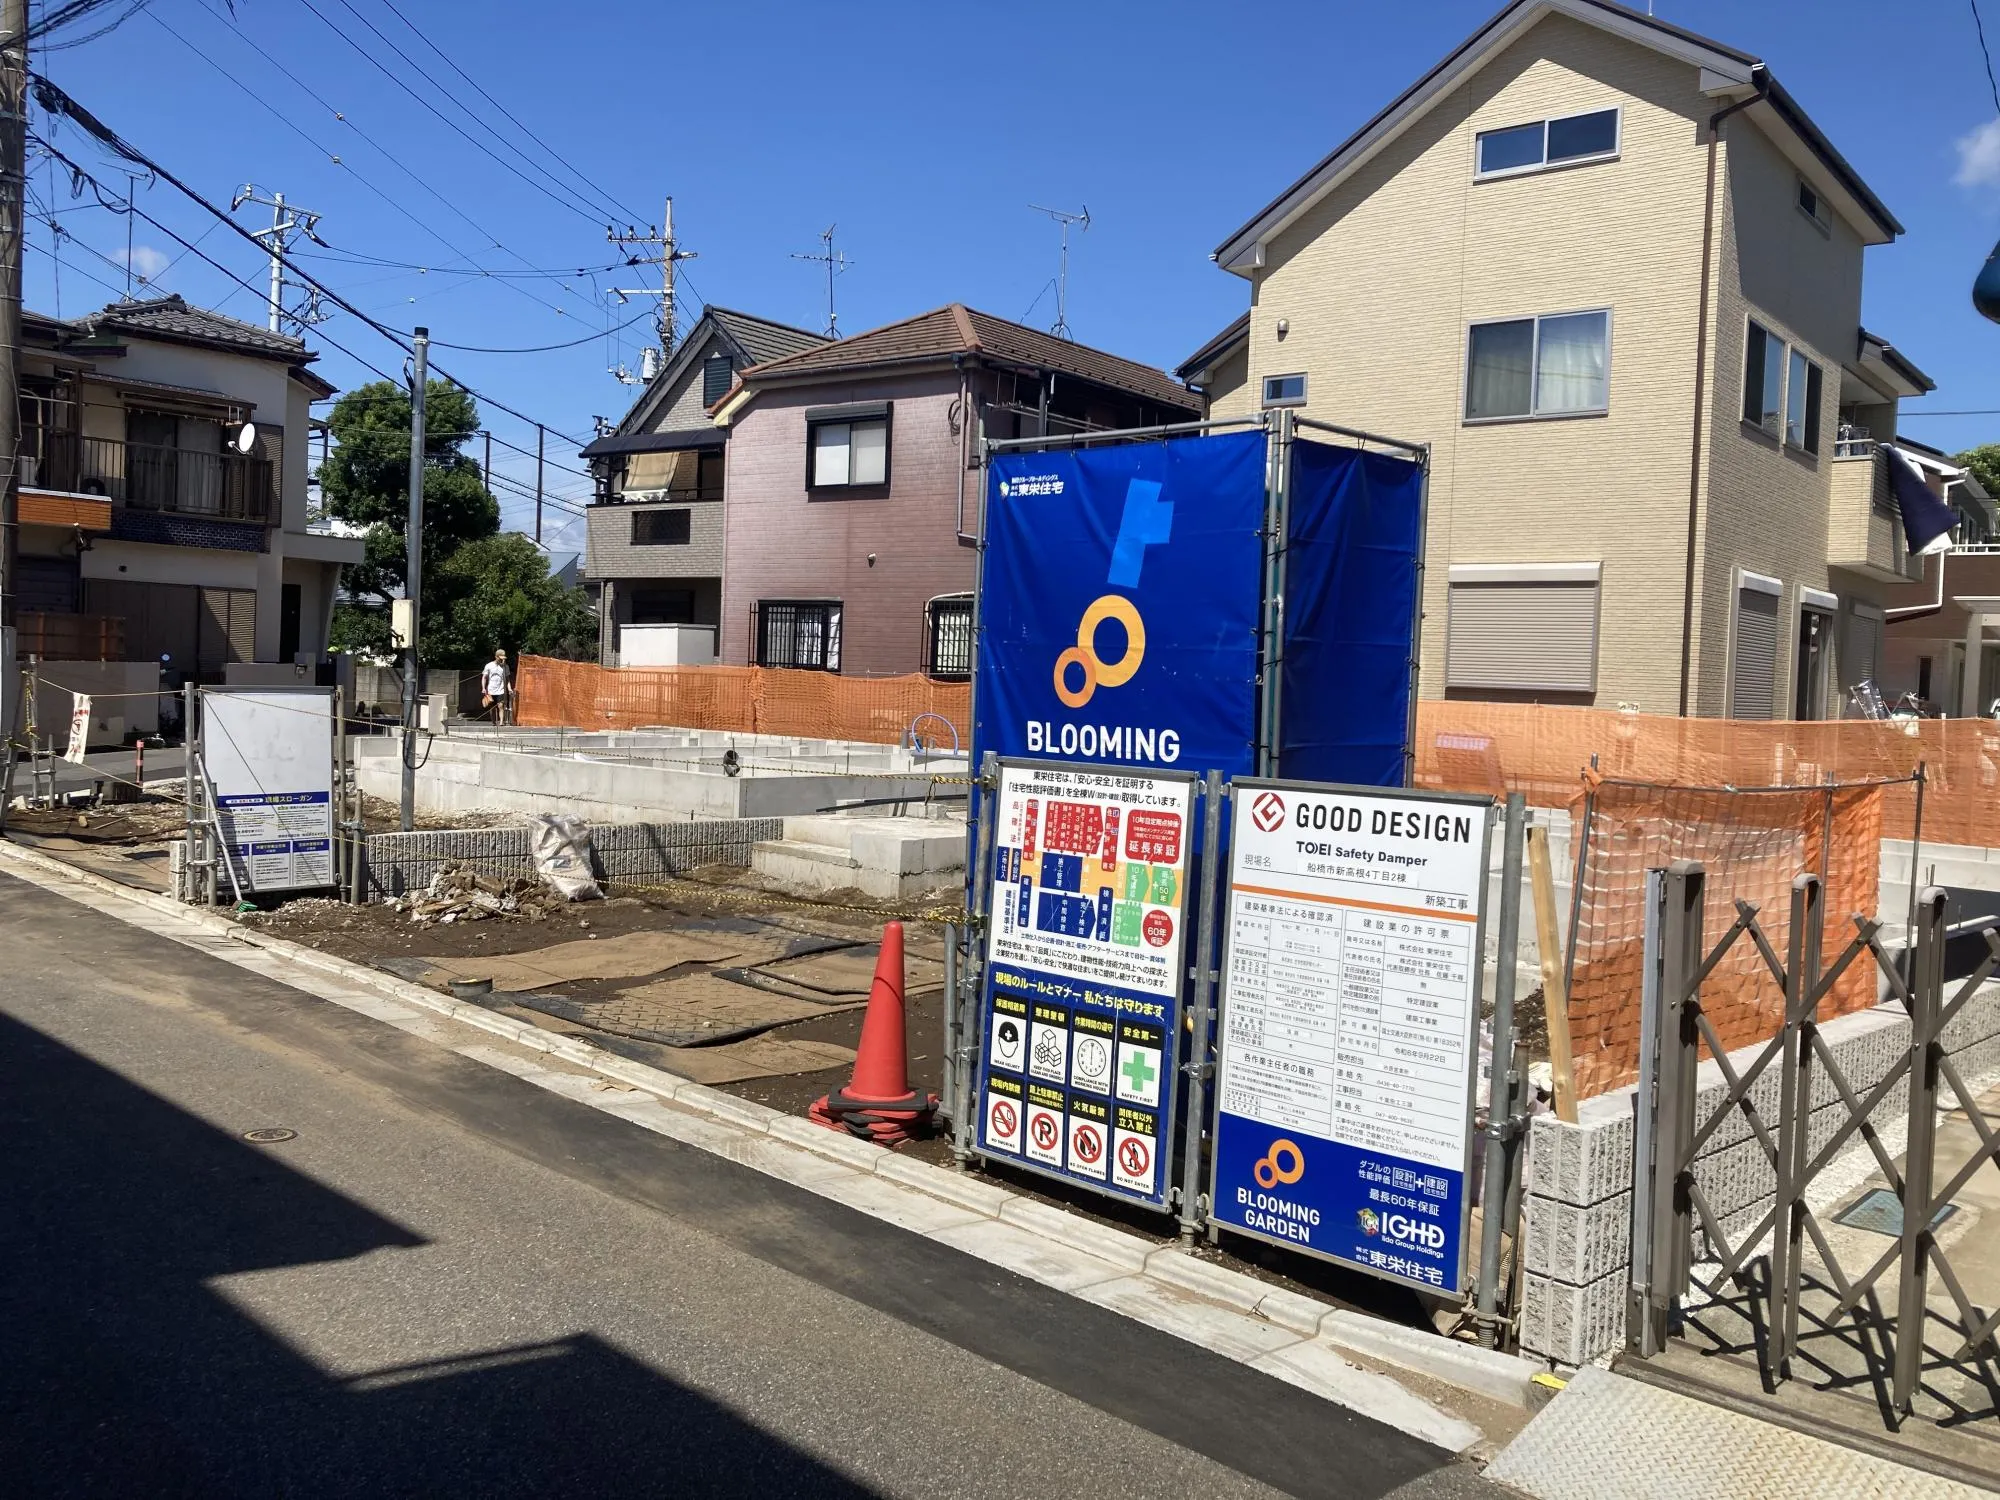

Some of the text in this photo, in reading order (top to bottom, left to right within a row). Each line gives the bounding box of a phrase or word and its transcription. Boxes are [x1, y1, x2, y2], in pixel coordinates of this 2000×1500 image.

[1018, 481, 1064, 496] 東栄住宅
[1027, 720, 1180, 762] BLOOMING
[1033, 771, 1154, 790] 東栄住宅は、「安心・安全」を証明する
[1296, 803, 1471, 844] GOOD DESIGN
[1129, 840, 1176, 857] 延長保証
[1244, 854, 1272, 868] 現場名
[1336, 847, 1374, 863] Safety
[1378, 851, 1428, 868] Damper
[1306, 862, 1407, 884] 船橋市新高根4丁目2棟
[1425, 894, 1469, 910] 新築工事
[1244, 902, 1334, 922] 建築基準法による確認済
[1148, 927, 1167, 938] 60年
[1363, 918, 1450, 938] 建設業の許可票
[1345, 952, 1382, 964] 代表者の氏名
[1399, 944, 1453, 958] 株式会社 東栄住宅
[1400, 958, 1451, 971] 株式会社 東栄住宅
[995, 971, 1165, 1018] 現場のルールとマナー 私たちは守ります
[1406, 998, 1438, 1008] 特定建設業
[1406, 1015, 1438, 1026] 建築工事業
[1123, 1026, 1158, 1040] 安全第一
[1244, 1053, 1315, 1078] 各作業主任者の職務
[1337, 1052, 1364, 1066] 販売担当
[1074, 1076, 1098, 1085] COMPLIANCE
[1336, 1068, 1363, 1081] 連絡先
[1122, 1092, 1138, 1100] SAFETY
[1336, 1084, 1362, 1097] 工事担当
[1074, 1101, 1105, 1117] 火気厳禁
[1335, 1100, 1362, 1113] 連絡先
[1118, 1108, 1152, 1124] 関係者以外
[1118, 1118, 1152, 1134] 立入禁止
[998, 1140, 1015, 1148] SMOKING
[1038, 1152, 1056, 1161] PARKING
[1360, 1160, 1392, 1175] ダブルの
[1358, 1168, 1391, 1185] 性能評価
[1394, 1170, 1414, 1182] 設計
[1426, 1176, 1446, 1191] 建設
[1134, 1180, 1150, 1188] ENTER
[1238, 1187, 1320, 1226] BLOOMING
[1369, 1188, 1440, 1216] 最長60年保証
[1246, 1209, 1310, 1243] GARDEN
[1395, 1240, 1416, 1251] Group
[1416, 1245, 1444, 1259] Holdings
[1369, 1250, 1444, 1286] 東栄住宅
